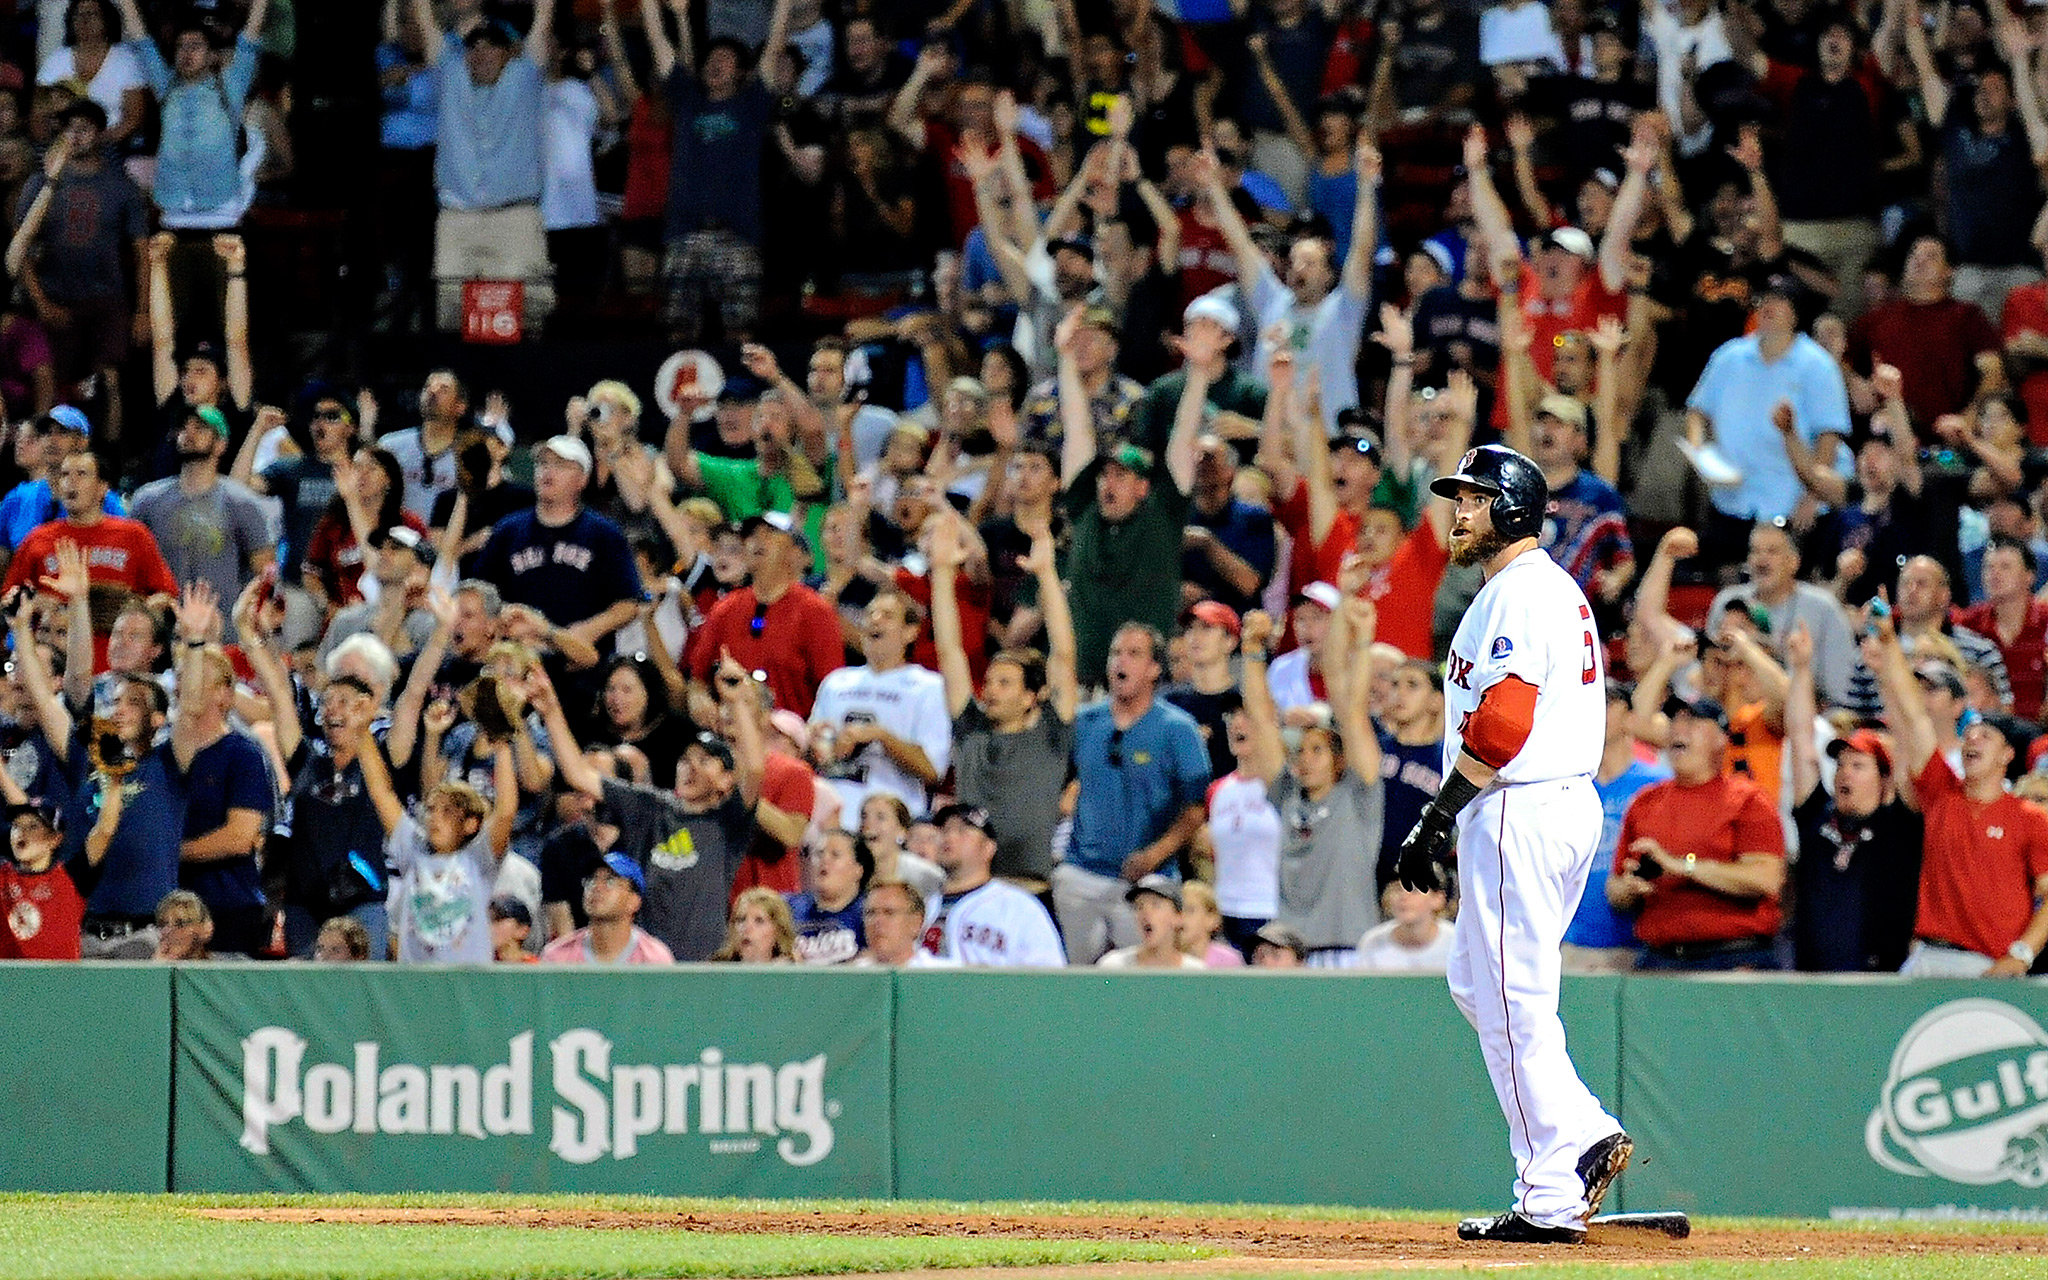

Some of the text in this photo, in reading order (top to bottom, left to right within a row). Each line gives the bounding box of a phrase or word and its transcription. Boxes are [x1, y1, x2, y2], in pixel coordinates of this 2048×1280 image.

[468, 310, 518, 337] 116
[239, 1026, 834, 1166] Poland Spring
[1894, 1051, 2048, 1132] Gulf
